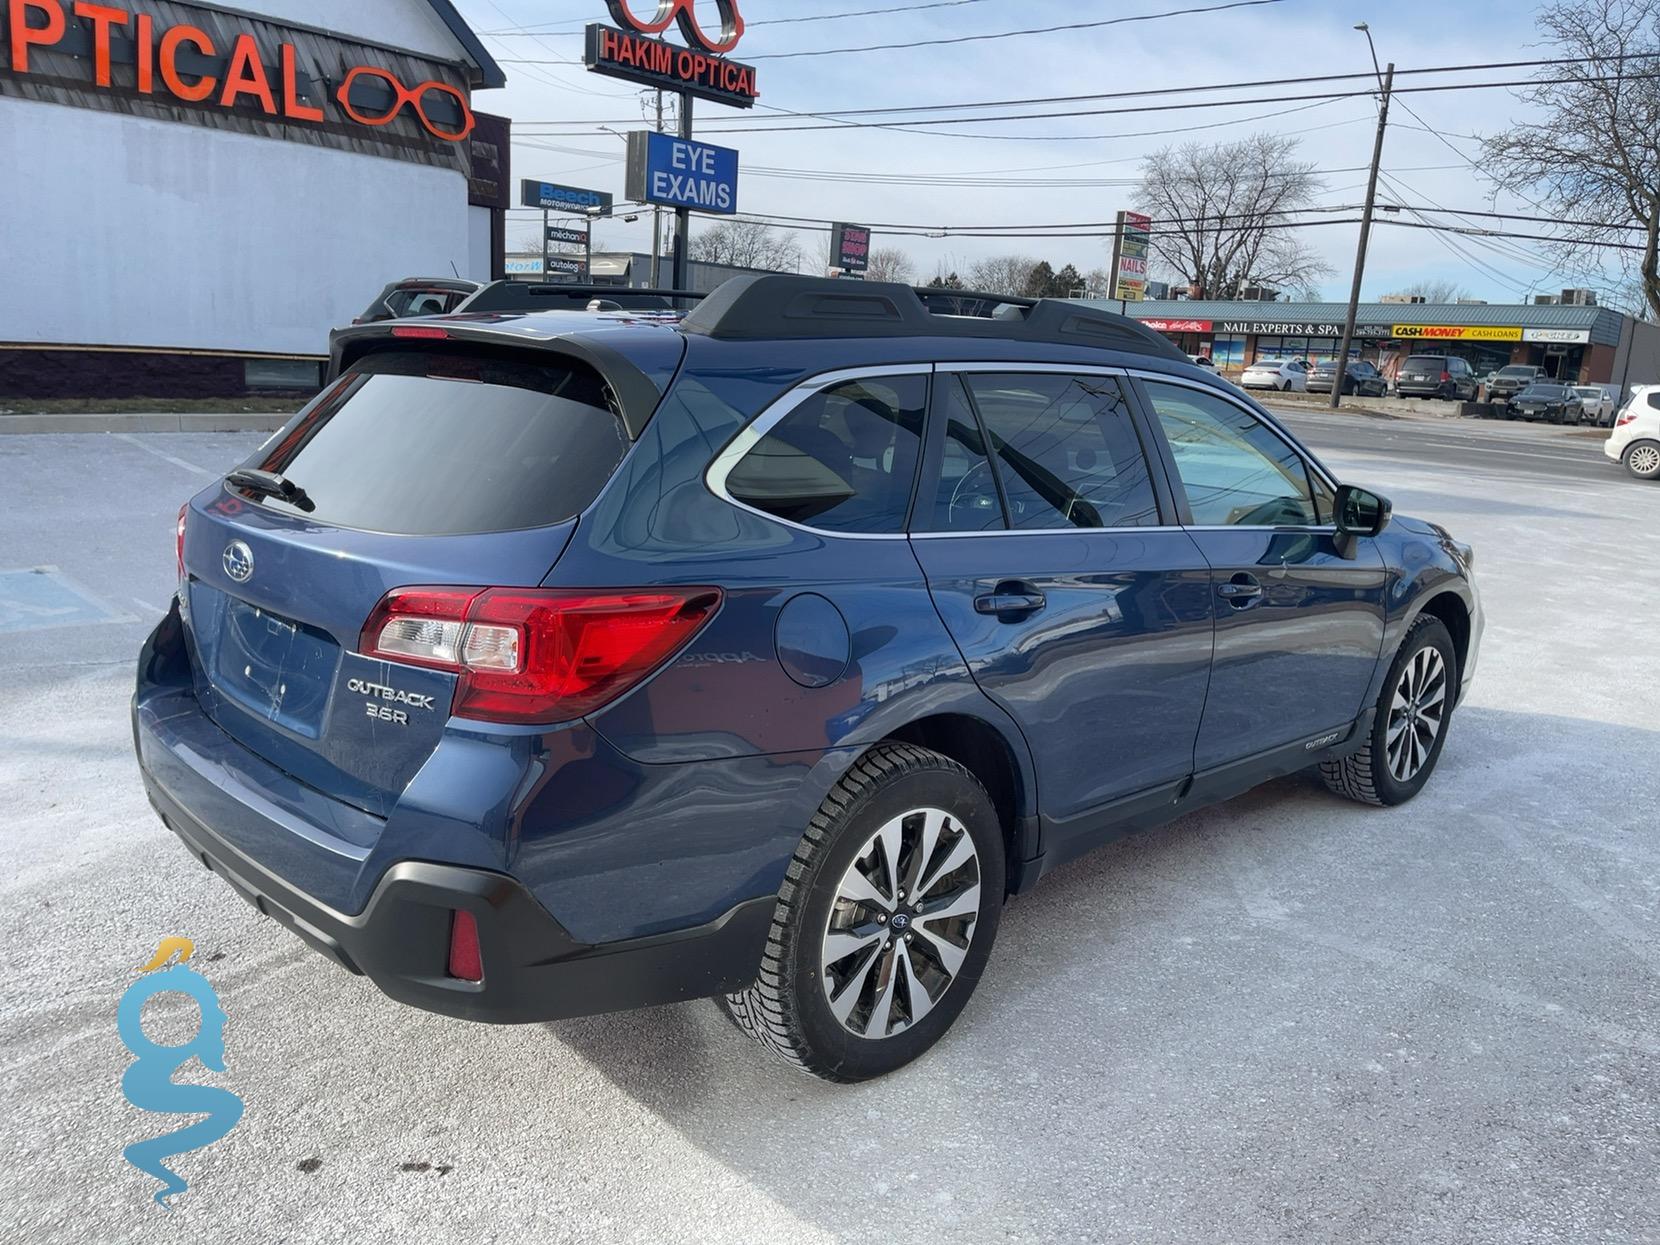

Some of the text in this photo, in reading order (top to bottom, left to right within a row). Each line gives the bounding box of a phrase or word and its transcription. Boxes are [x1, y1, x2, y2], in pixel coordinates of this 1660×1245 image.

[601, 29, 760, 97] HAKIM OPTICAL
[672, 142, 715, 175] EYE
[540, 183, 600, 205] Beech
[653, 171, 730, 209] EXAMS
[1120, 258, 1146, 274] NAILS
[1223, 322, 1339, 335] NAIL EXPERTS & SPA
[1471, 329, 1494, 337] CASH
[347, 678, 435, 712] OUTBACK
